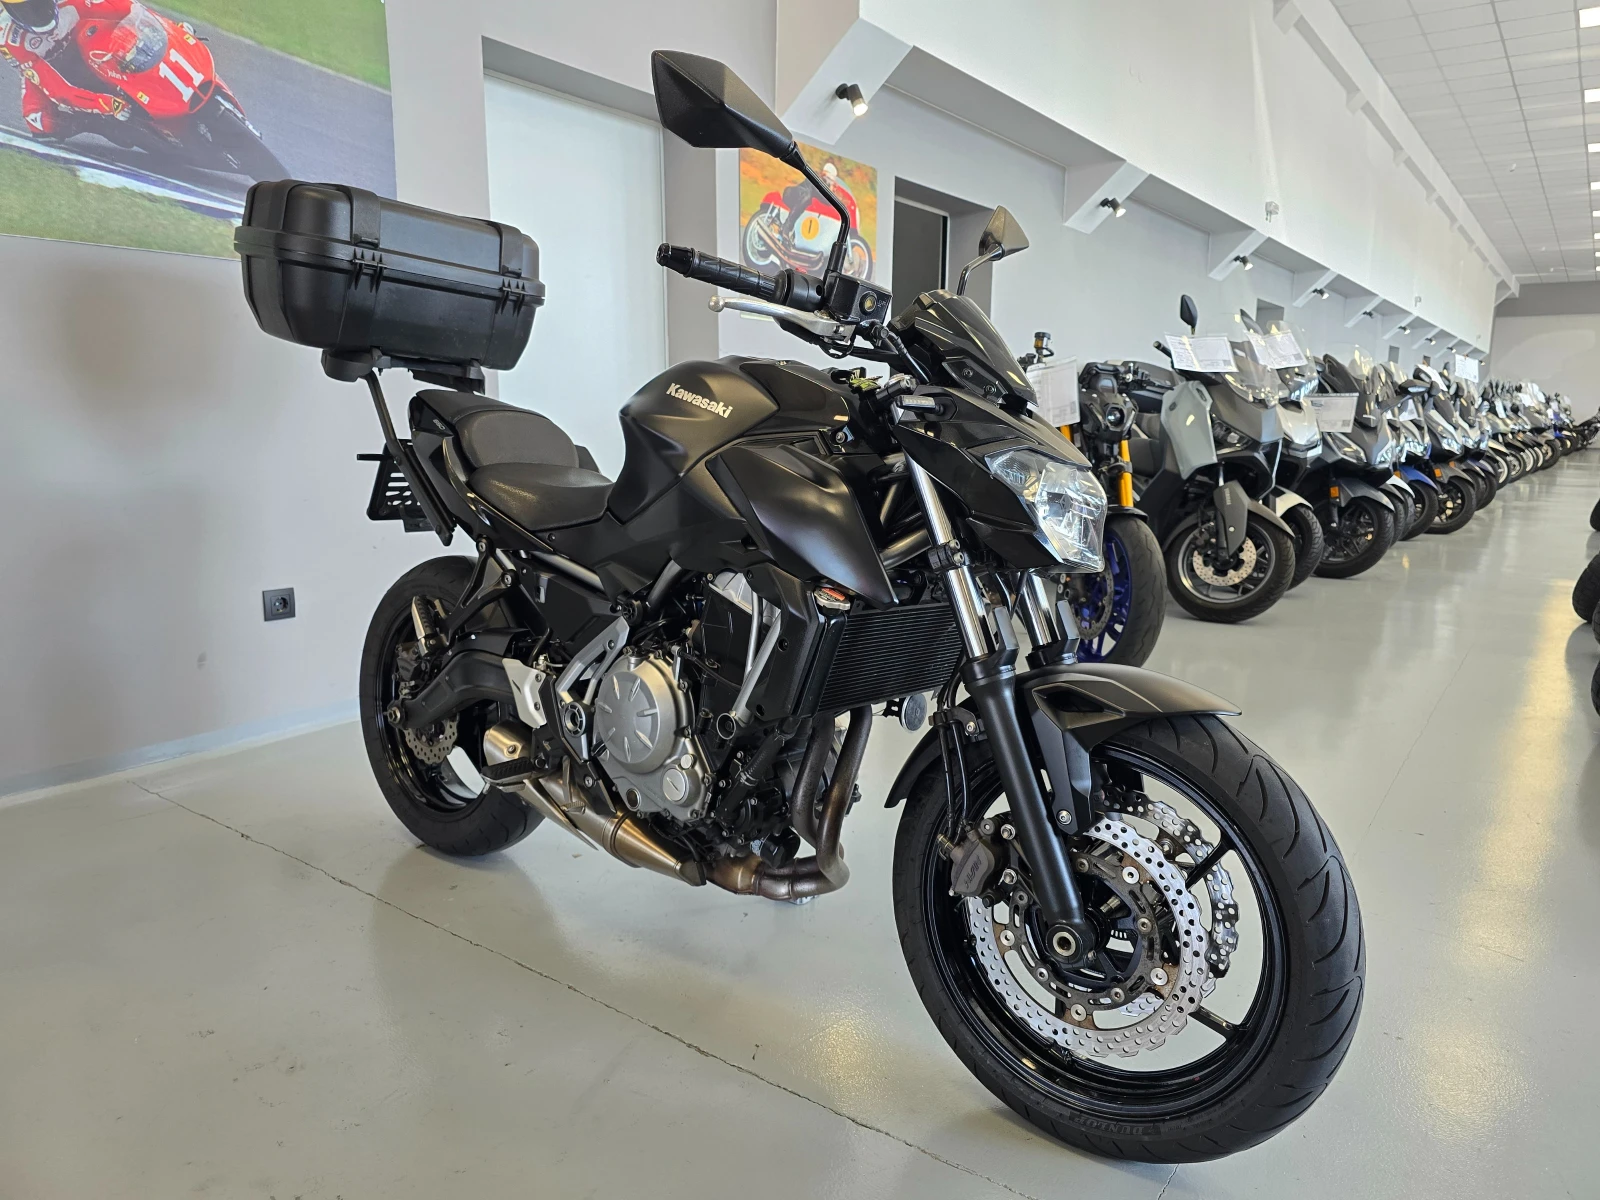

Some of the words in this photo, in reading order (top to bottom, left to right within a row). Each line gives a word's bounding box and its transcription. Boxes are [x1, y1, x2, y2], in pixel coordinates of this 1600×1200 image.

[158, 47, 205, 103] 11
[665, 382, 734, 419] Kawasaki
[1074, 1115, 1144, 1135] DUNLOP
